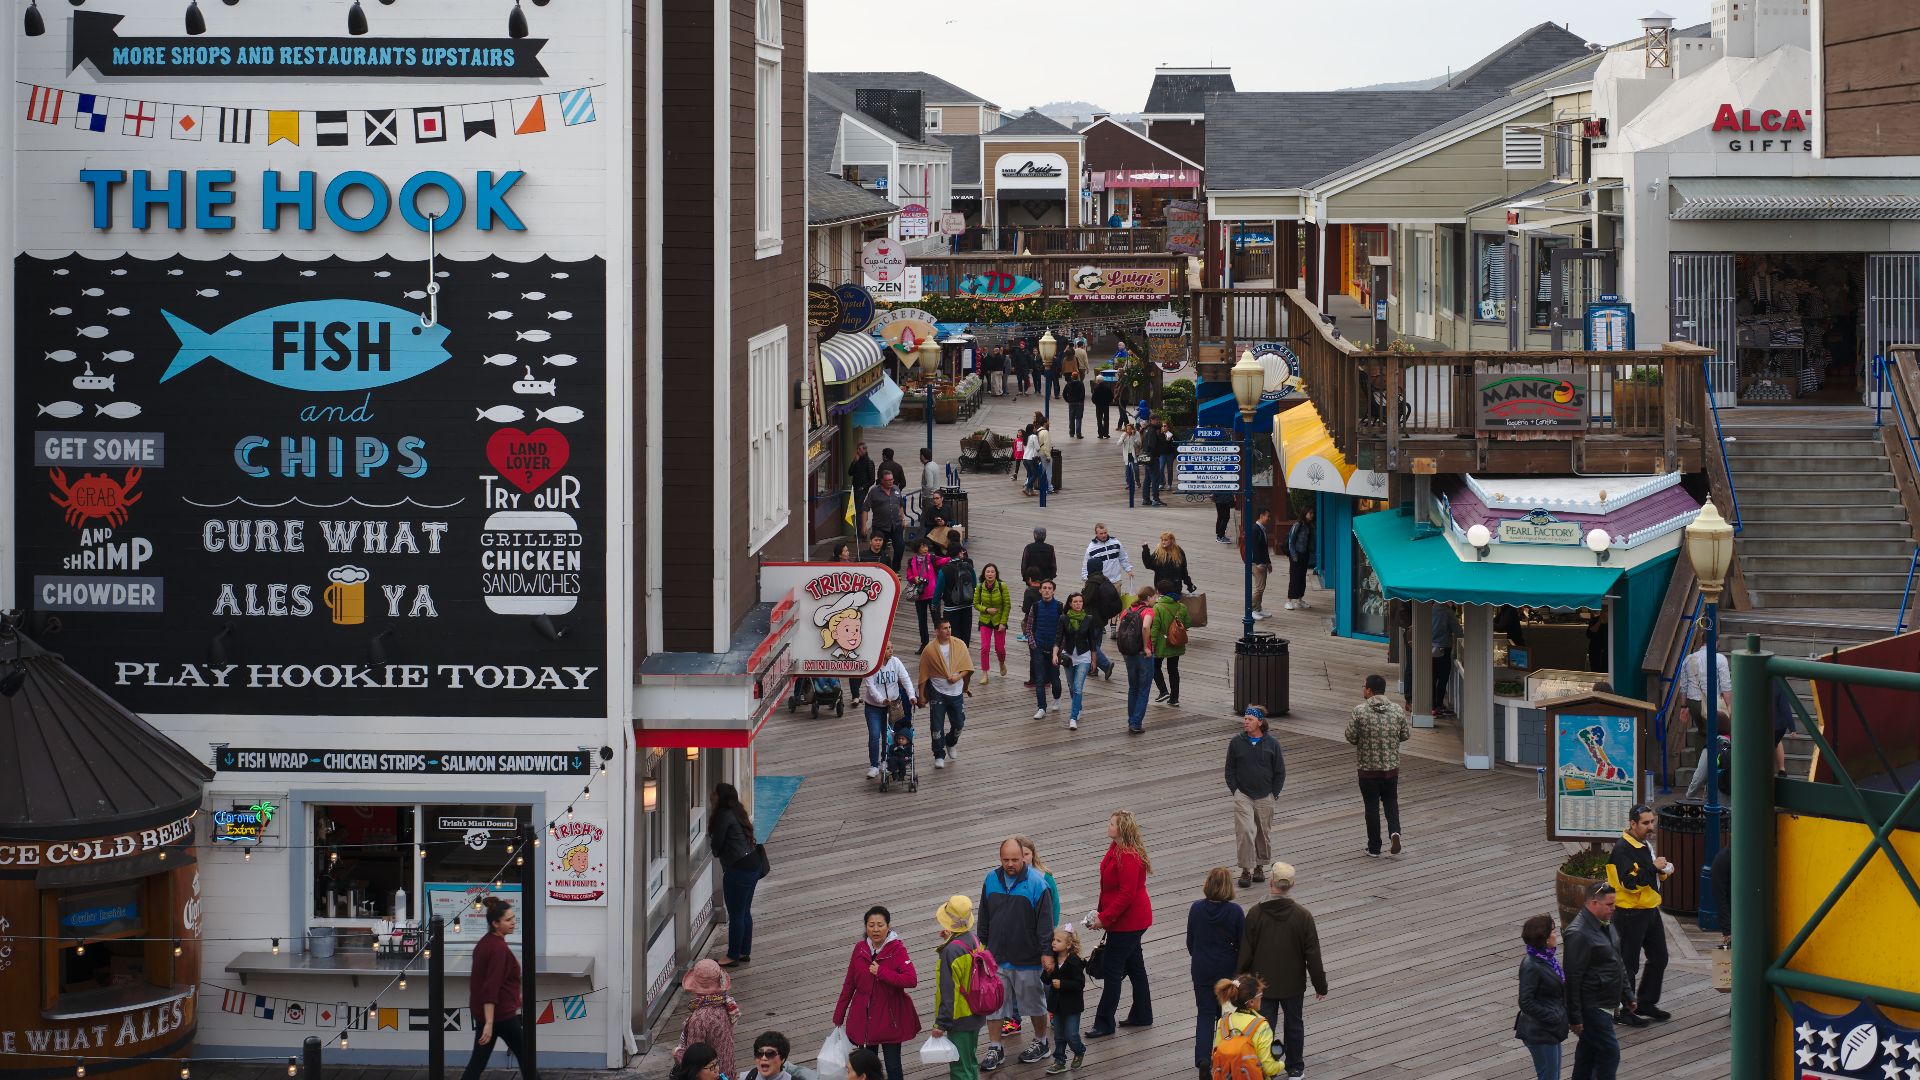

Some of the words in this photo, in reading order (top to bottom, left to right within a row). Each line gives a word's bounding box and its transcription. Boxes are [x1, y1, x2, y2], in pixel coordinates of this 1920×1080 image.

[112, 46, 166, 65] MORE
[171, 46, 231, 65] SHOPS
[236, 46, 275, 65] AND
[279, 46, 417, 66] RESTAURANTS
[421, 47, 515, 67] UPSTAIRS
[79, 170, 237, 231] THE
[262, 170, 529, 233] HOOK
[865, 282, 902, 292] naZEN
[983, 271, 1016, 293] 7D
[1107, 270, 1165, 287] Luigi's
[1115, 284, 1154, 294] pizzeria
[882, 309, 935, 324] CREPES
[272, 320, 392, 372] FISH
[300, 392, 374, 424] and
[45, 437, 87, 460] GET
[93, 438, 155, 461] SOME
[233, 435, 428, 478] CHIPS
[509, 442, 548, 456] LAND
[506, 456, 551, 470] LOVER
[524, 470, 534, 484] ?
[80, 527, 113, 547] AND
[203, 520, 305, 553] CURE
[319, 520, 448, 554] WHAT
[480, 533, 583, 547] GRILLED
[1505, 525, 1532, 535] PEARL
[1533, 526, 1574, 537] FACTORY
[481, 550, 581, 571] CHICKEN
[482, 572, 581, 594] SANDWICHES
[804, 571, 883, 601] TRISH'S
[42, 583, 156, 606] CHOWDER
[213, 583, 315, 617] ALES
[381, 584, 439, 617] YA
[803, 660, 828, 671] MINI
[829, 660, 869, 671] DONUTS
[114, 661, 239, 687] PLAY
[246, 663, 429, 689] HOOKIE
[437, 665, 599, 691] TODAY
[1618, 722, 1630, 732] 39
[237, 752, 266, 769] FISH
[269, 752, 309, 769] WRAP
[323, 753, 378, 770] CHICKEN
[379, 754, 426, 771] STRIPS
[441, 755, 496, 772] SALMON
[498, 755, 568, 772] SANDWICH
[214, 811, 256, 825] Corona
[441, 819, 468, 827] Trish's
[226, 823, 256, 835] Extra
[46, 835, 136, 864] COLD
[140, 816, 193, 850] BEER
[555, 879, 572, 888] MINI
[24, 1024, 109, 1053] WHAT
[115, 998, 184, 1048] ALES
